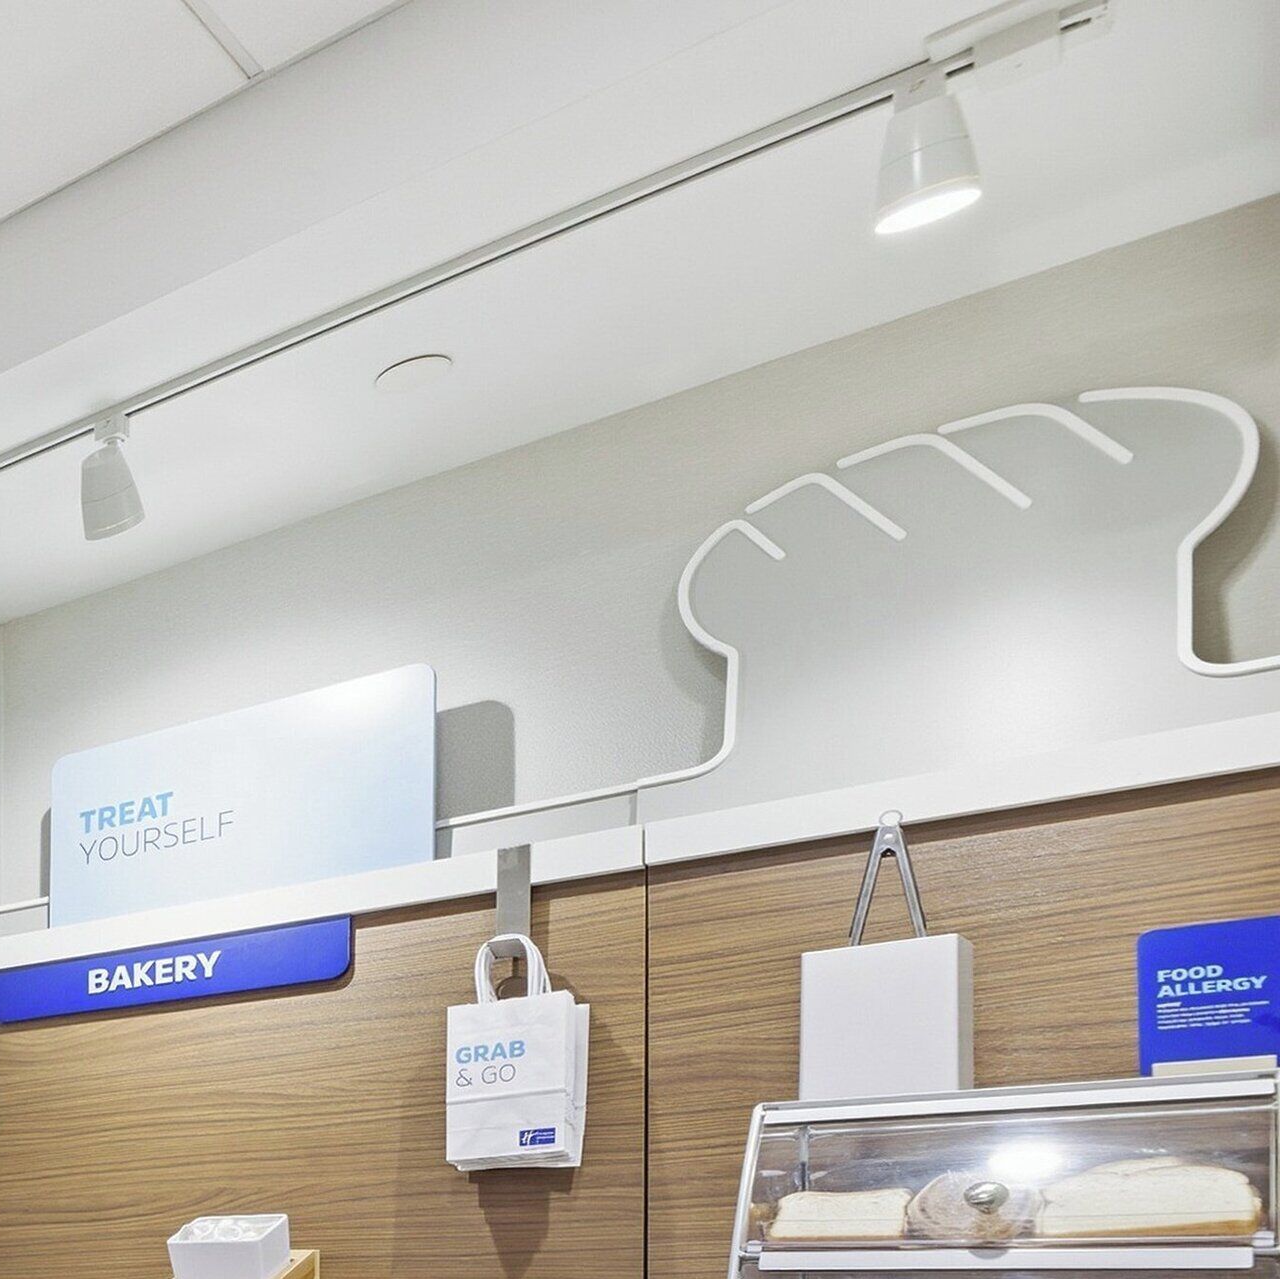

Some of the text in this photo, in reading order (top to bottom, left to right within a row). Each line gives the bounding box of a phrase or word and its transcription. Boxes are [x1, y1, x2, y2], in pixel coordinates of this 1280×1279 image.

[79, 791, 174, 835] TREAT
[79, 809, 235, 865] YOURSELF
[86, 949, 222, 996] BAKERY
[1156, 964, 1224, 983] FOOD
[1156, 975, 1268, 999] ALLERGY
[455, 1039, 526, 1064] GRAB
[455, 1063, 517, 1088] & GO
